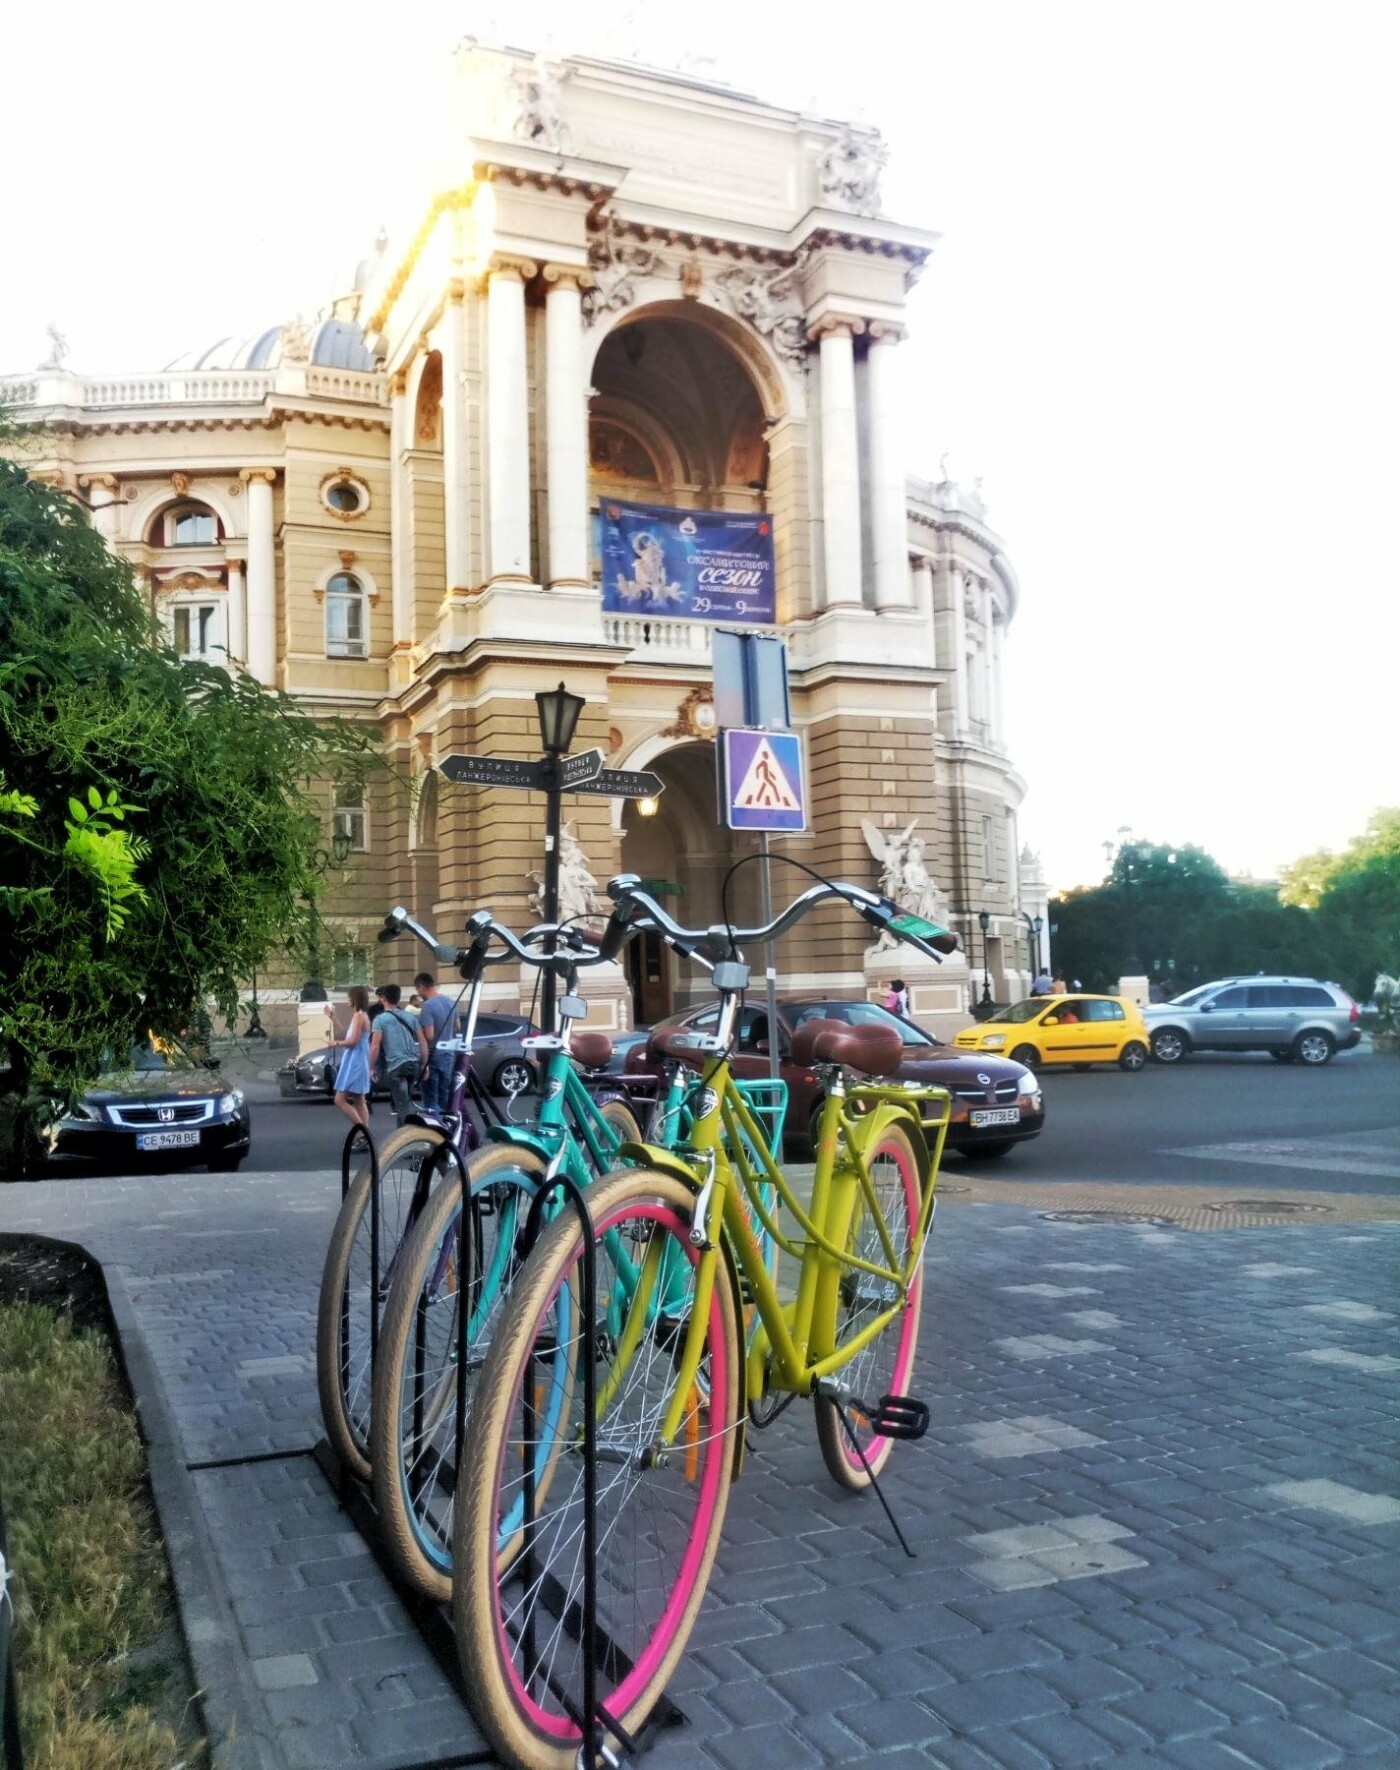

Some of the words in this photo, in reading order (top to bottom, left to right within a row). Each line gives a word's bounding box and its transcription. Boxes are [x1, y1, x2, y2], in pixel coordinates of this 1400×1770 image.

[691, 596, 712, 613] 29
[735, 600, 748, 615] 9
[468, 760, 519, 772] ВУЛИЦЯ
[599, 772, 638, 784] УЛИЦЯ
[143, 1135, 158, 1146] CE
[160, 1133, 183, 1145] 9478
[184, 1132, 198, 1143] BE
